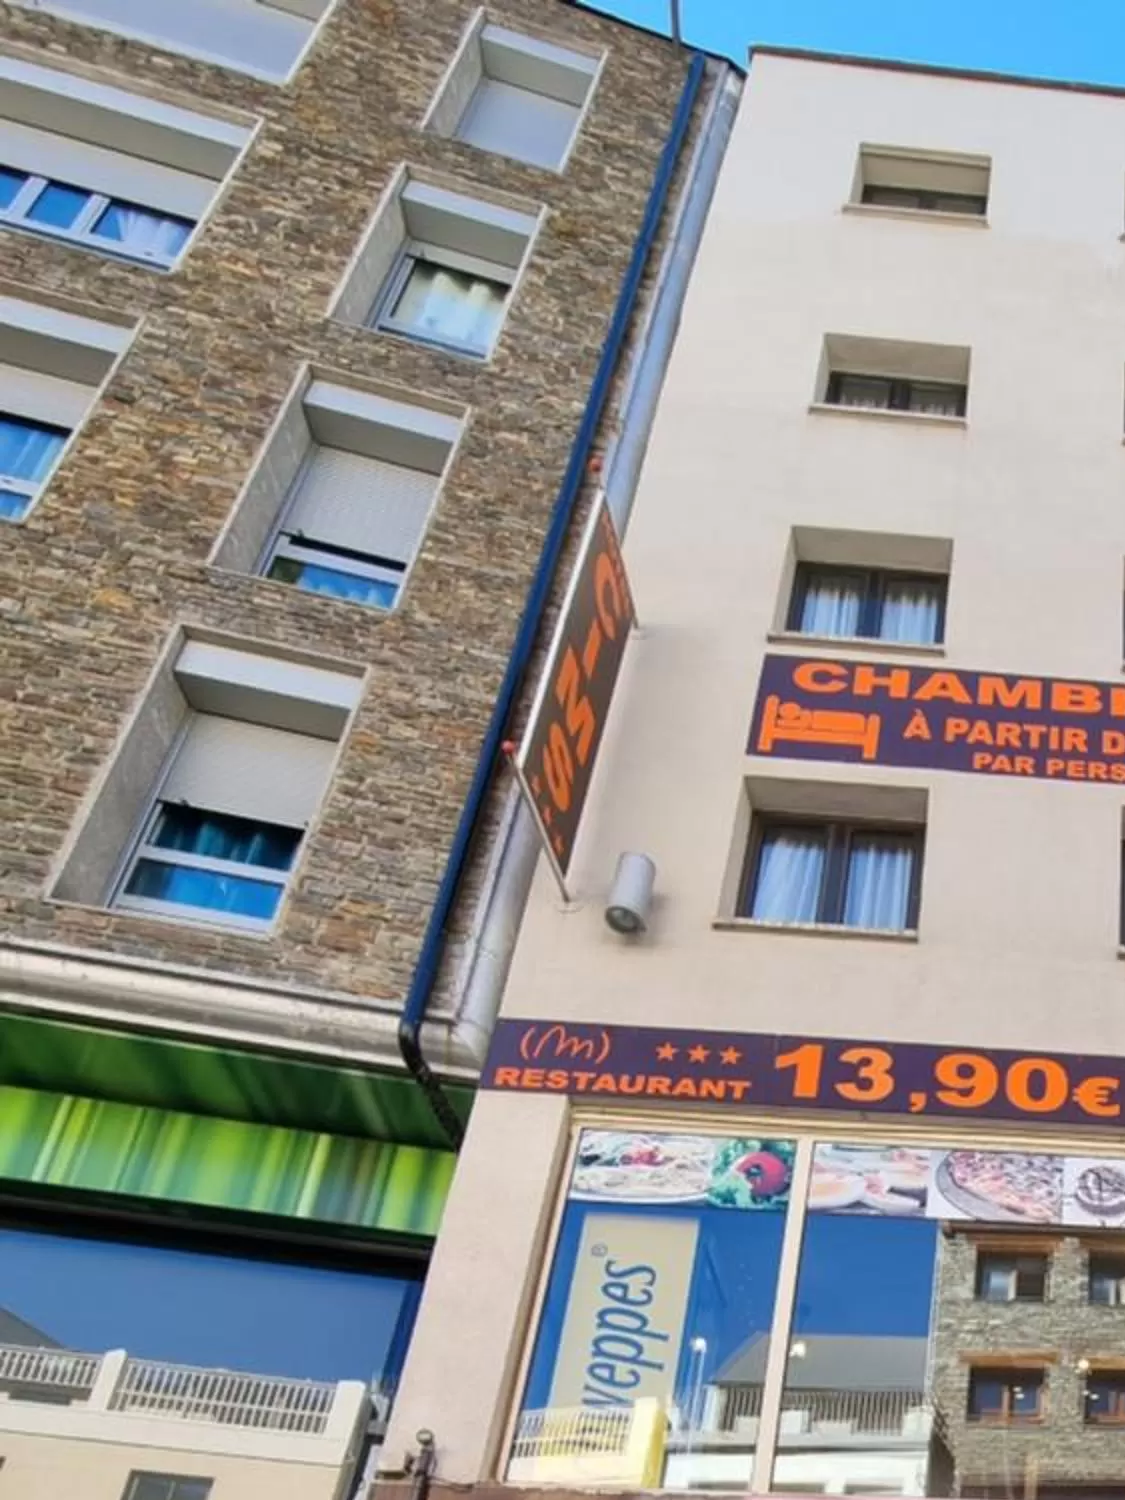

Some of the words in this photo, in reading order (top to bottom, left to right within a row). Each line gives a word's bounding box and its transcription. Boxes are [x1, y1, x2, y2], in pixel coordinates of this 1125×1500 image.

[903, 708, 933, 741] À
[945, 718, 1089, 754] PARTIR
[972, 751, 1036, 776] PAR
[494, 1067, 751, 1100] RESTAURANT
[774, 1043, 1121, 1117] 13,90€
